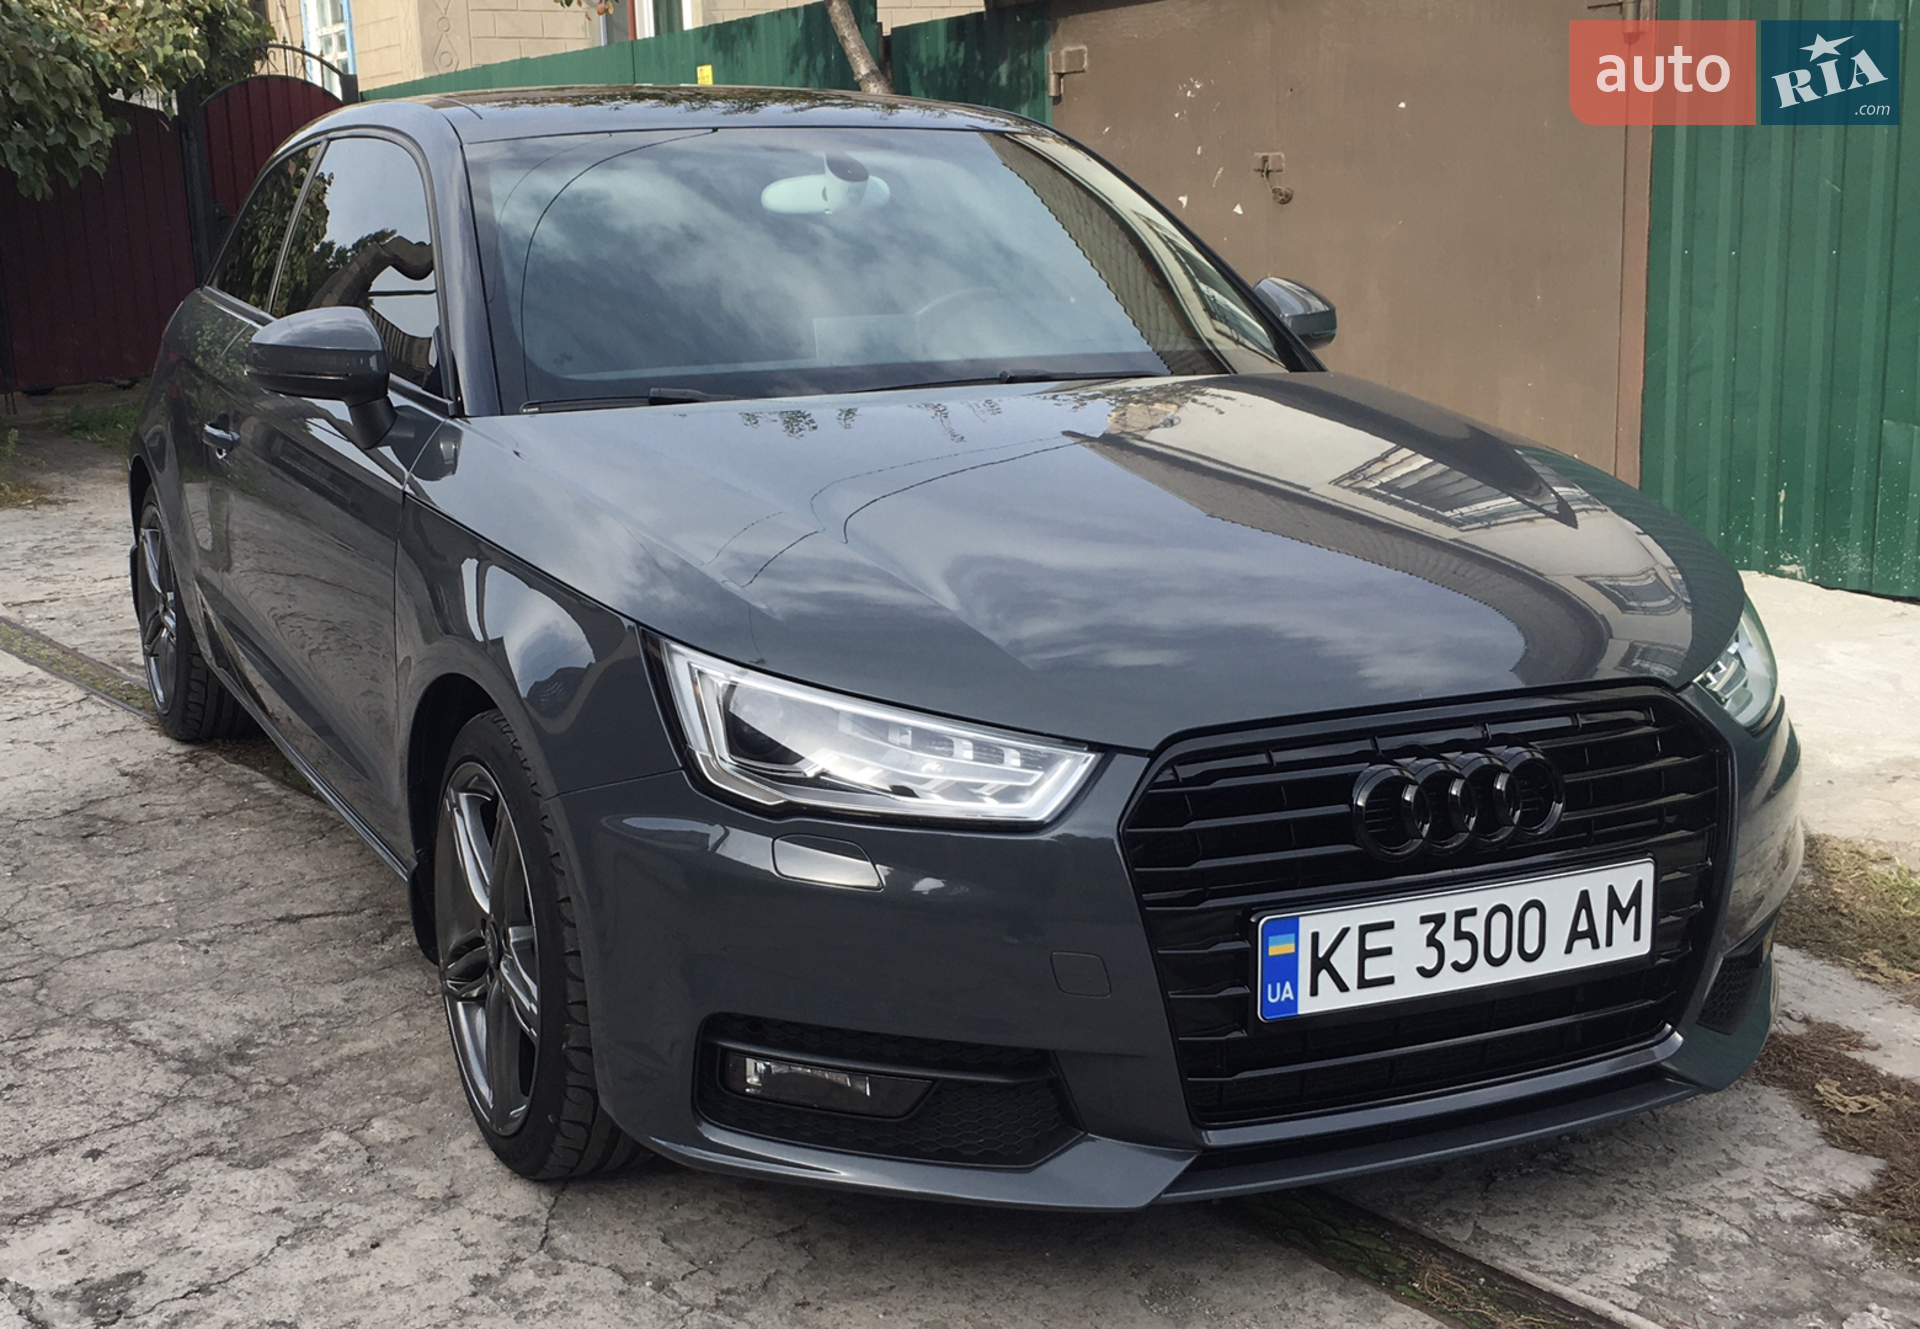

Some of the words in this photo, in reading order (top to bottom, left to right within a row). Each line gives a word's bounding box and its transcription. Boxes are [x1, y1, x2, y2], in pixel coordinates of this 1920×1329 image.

[1309, 920, 1396, 998] KE
[1415, 898, 1547, 979] 3500
[1563, 878, 1643, 956] AM
[1267, 980, 1295, 1004] UA
